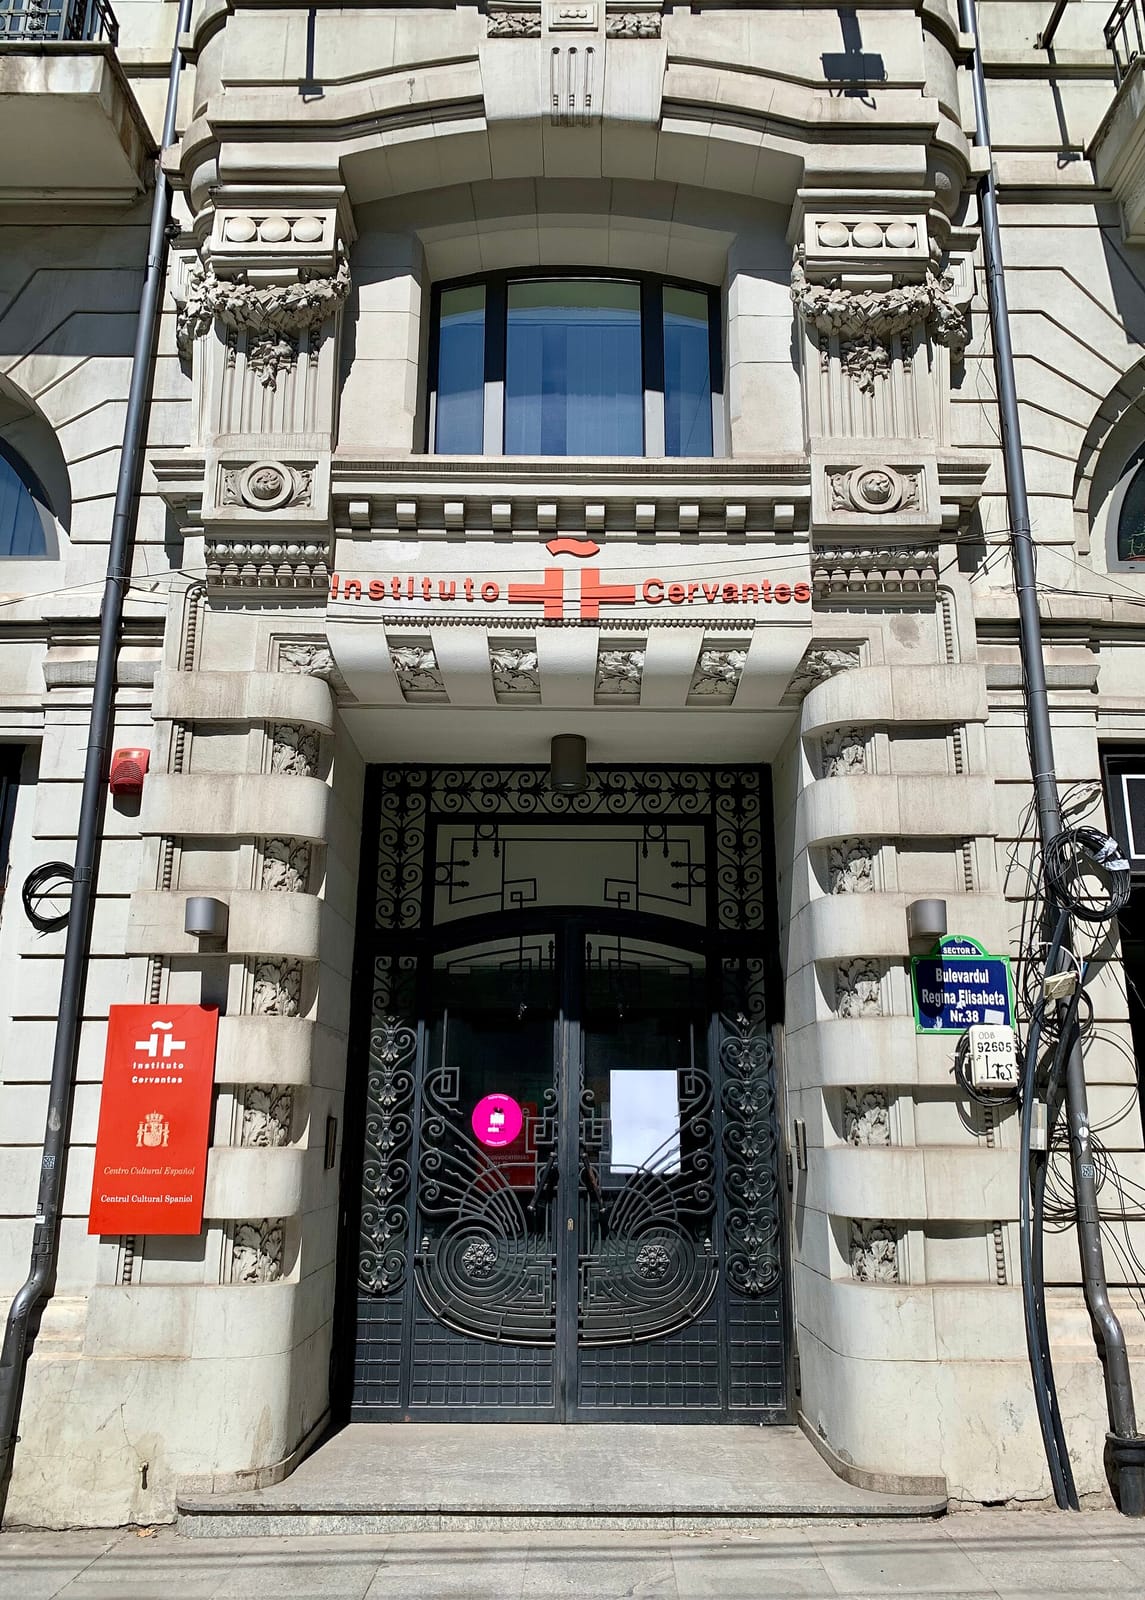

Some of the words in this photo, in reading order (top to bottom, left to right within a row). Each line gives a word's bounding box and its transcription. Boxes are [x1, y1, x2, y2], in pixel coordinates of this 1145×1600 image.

[331, 574, 500, 602] Instituto
[642, 578, 811, 604] Cervantes
[943, 946, 970, 955] SECTOR
[971, 946, 976, 955] 5
[935, 967, 989, 984] Bulevardul
[922, 988, 956, 1008] Regina
[958, 989, 1005, 1006] Elisabeta
[950, 1009, 979, 1023] Nr.38
[977, 1041, 1012, 1053] 92605
[132, 1061, 184, 1070] Instituto
[131, 1075, 183, 1084] Cervantes
[104, 1166, 129, 1175] Centro
[130, 1166, 162, 1175] Cultural
[164, 1167, 195, 1177] Español
[101, 1194, 130, 1203] Centrul
[131, 1194, 163, 1203] Cultural
[165, 1194, 193, 1204] Spaniol
